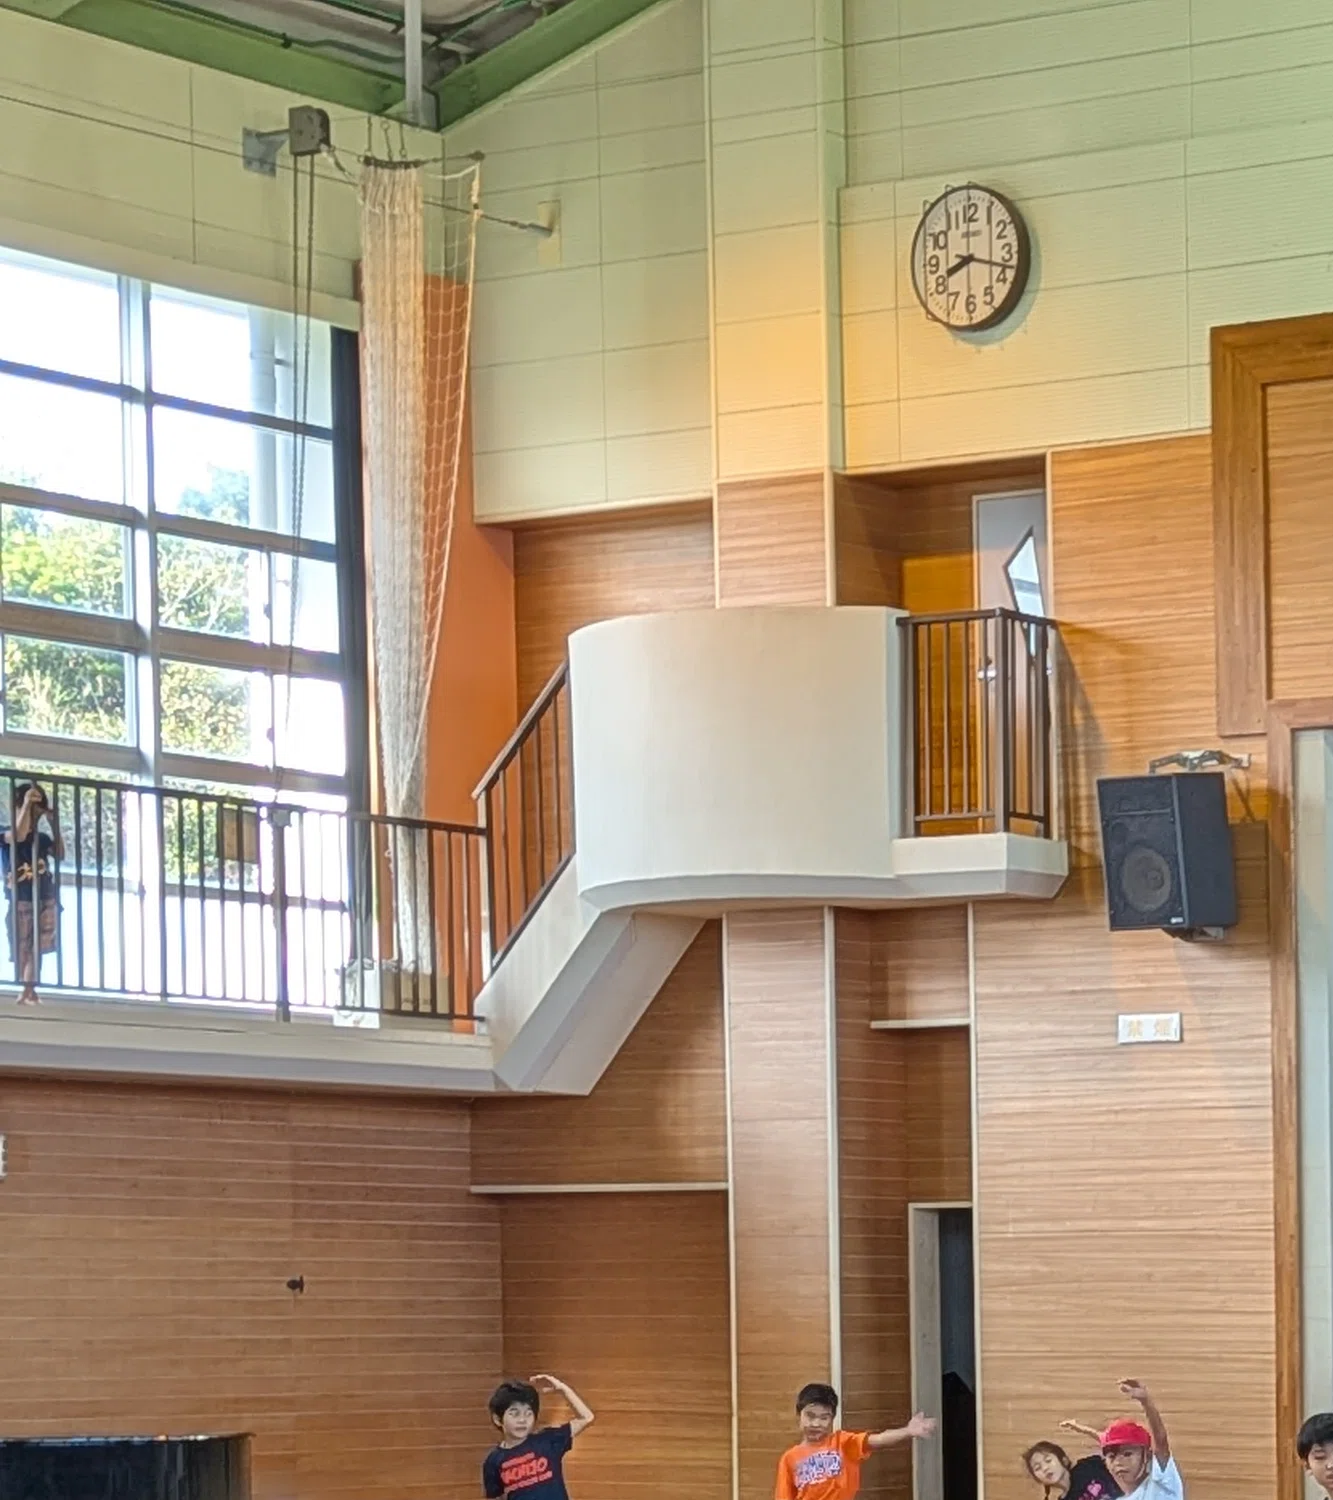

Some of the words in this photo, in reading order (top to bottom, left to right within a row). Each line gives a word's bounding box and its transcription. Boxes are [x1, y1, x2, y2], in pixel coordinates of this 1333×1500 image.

[962, 202, 979, 224] 12
[996, 219, 1007, 240] 2
[928, 230, 948, 251] 10
[1001, 243, 1013, 262] 3
[928, 254, 940, 275] 9
[935, 275, 948, 295] 8
[996, 267, 1008, 285] 4
[948, 291, 960, 311] 7
[965, 294, 977, 314] 6
[983, 286, 995, 306] 5
